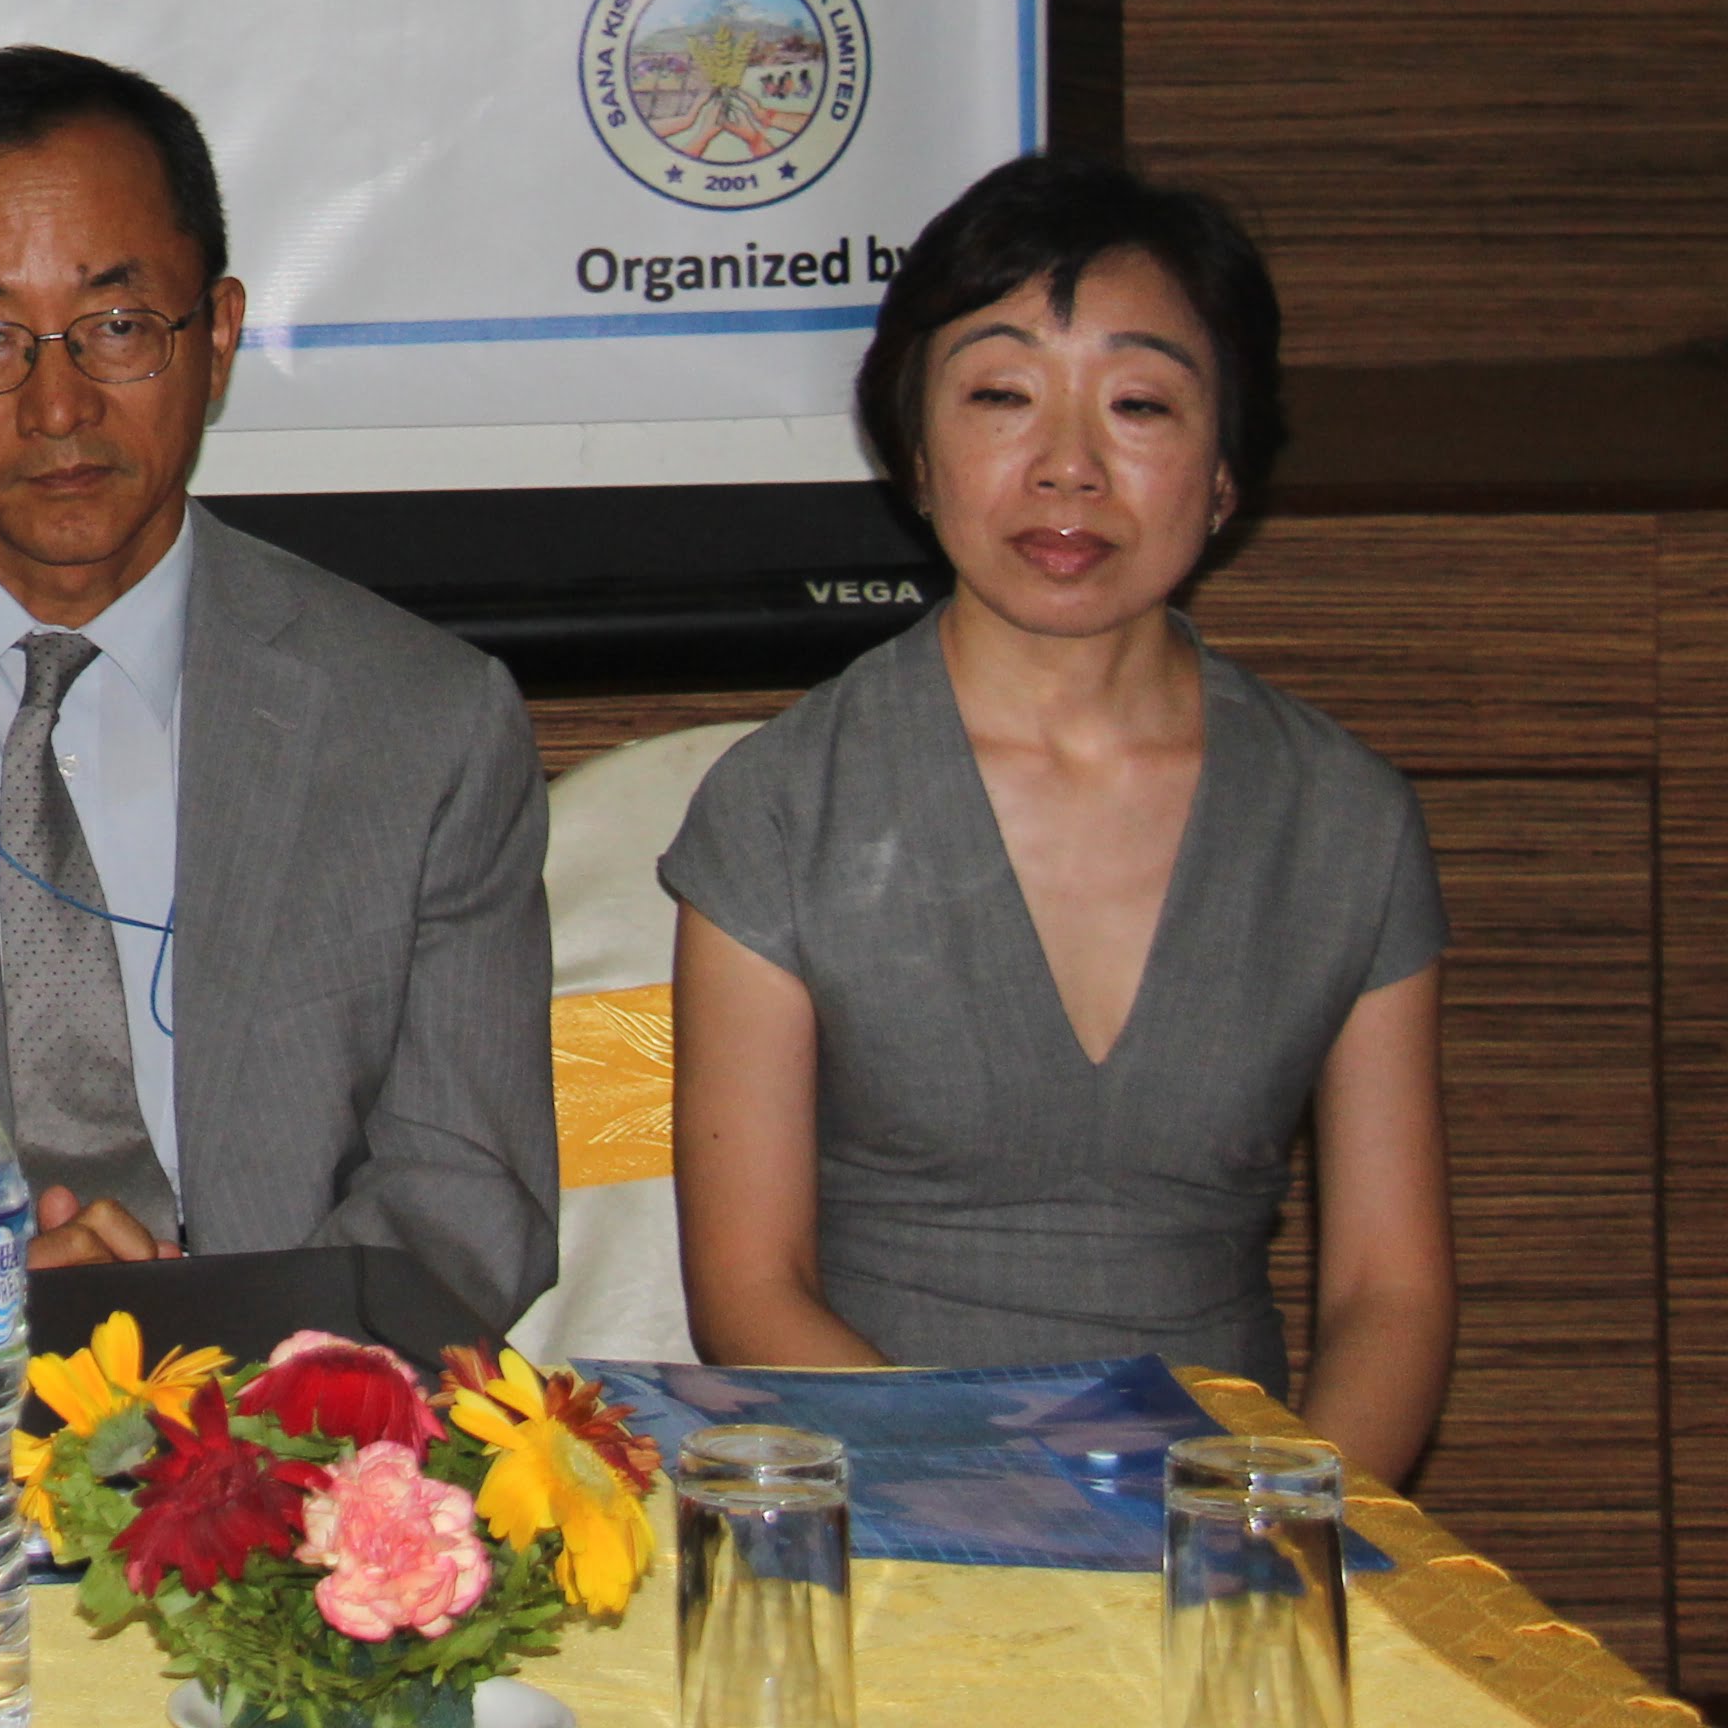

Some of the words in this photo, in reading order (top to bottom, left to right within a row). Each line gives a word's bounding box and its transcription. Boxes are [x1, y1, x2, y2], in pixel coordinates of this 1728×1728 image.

[597, 46, 627, 128] SANA
[828, 8, 859, 122] LIMITED
[704, 173, 759, 192] 2001
[576, 237, 851, 303] Organized
[805, 581, 923, 603] VEGA
